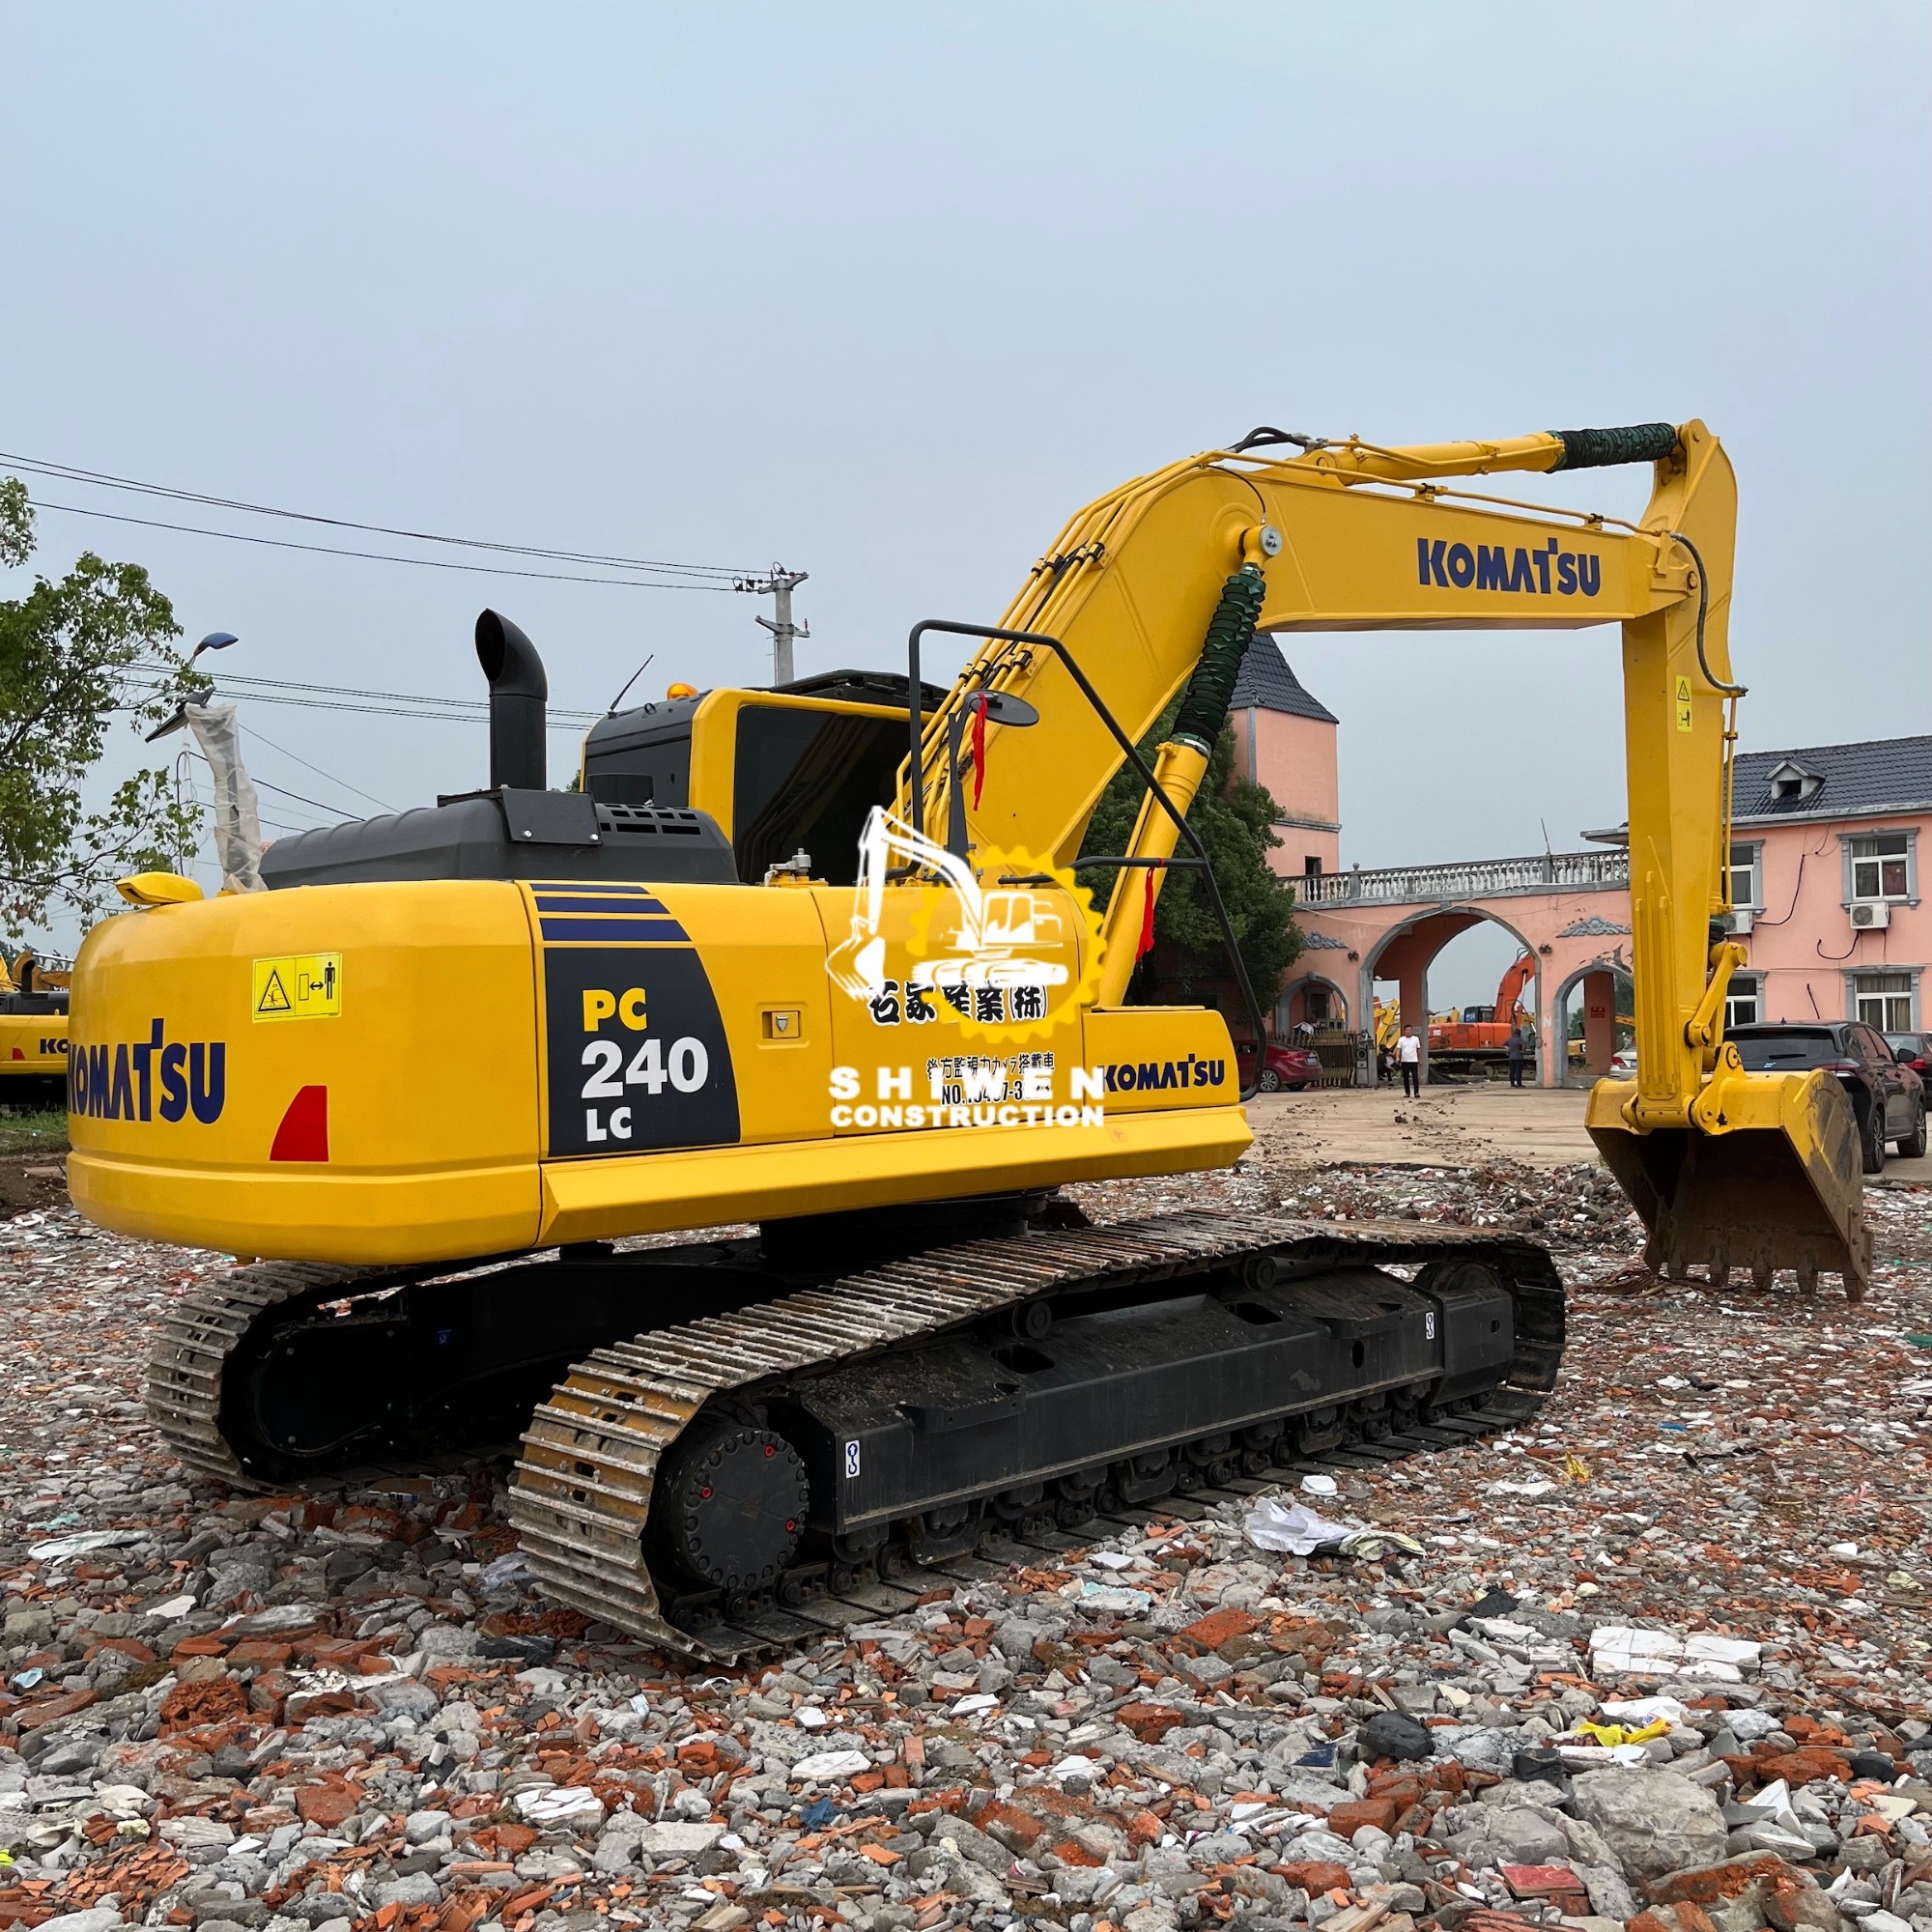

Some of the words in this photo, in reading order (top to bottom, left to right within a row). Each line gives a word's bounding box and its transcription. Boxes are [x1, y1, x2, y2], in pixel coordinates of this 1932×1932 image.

[1417, 537, 1601, 597] KOMATSU
[582, 987, 647, 1032] PC
[68, 1018, 226, 1125] KOMATSU
[582, 1037, 709, 1099] 240
[1097, 1053, 1225, 1093] KOMATSU
[586, 1106, 632, 1142] LC
